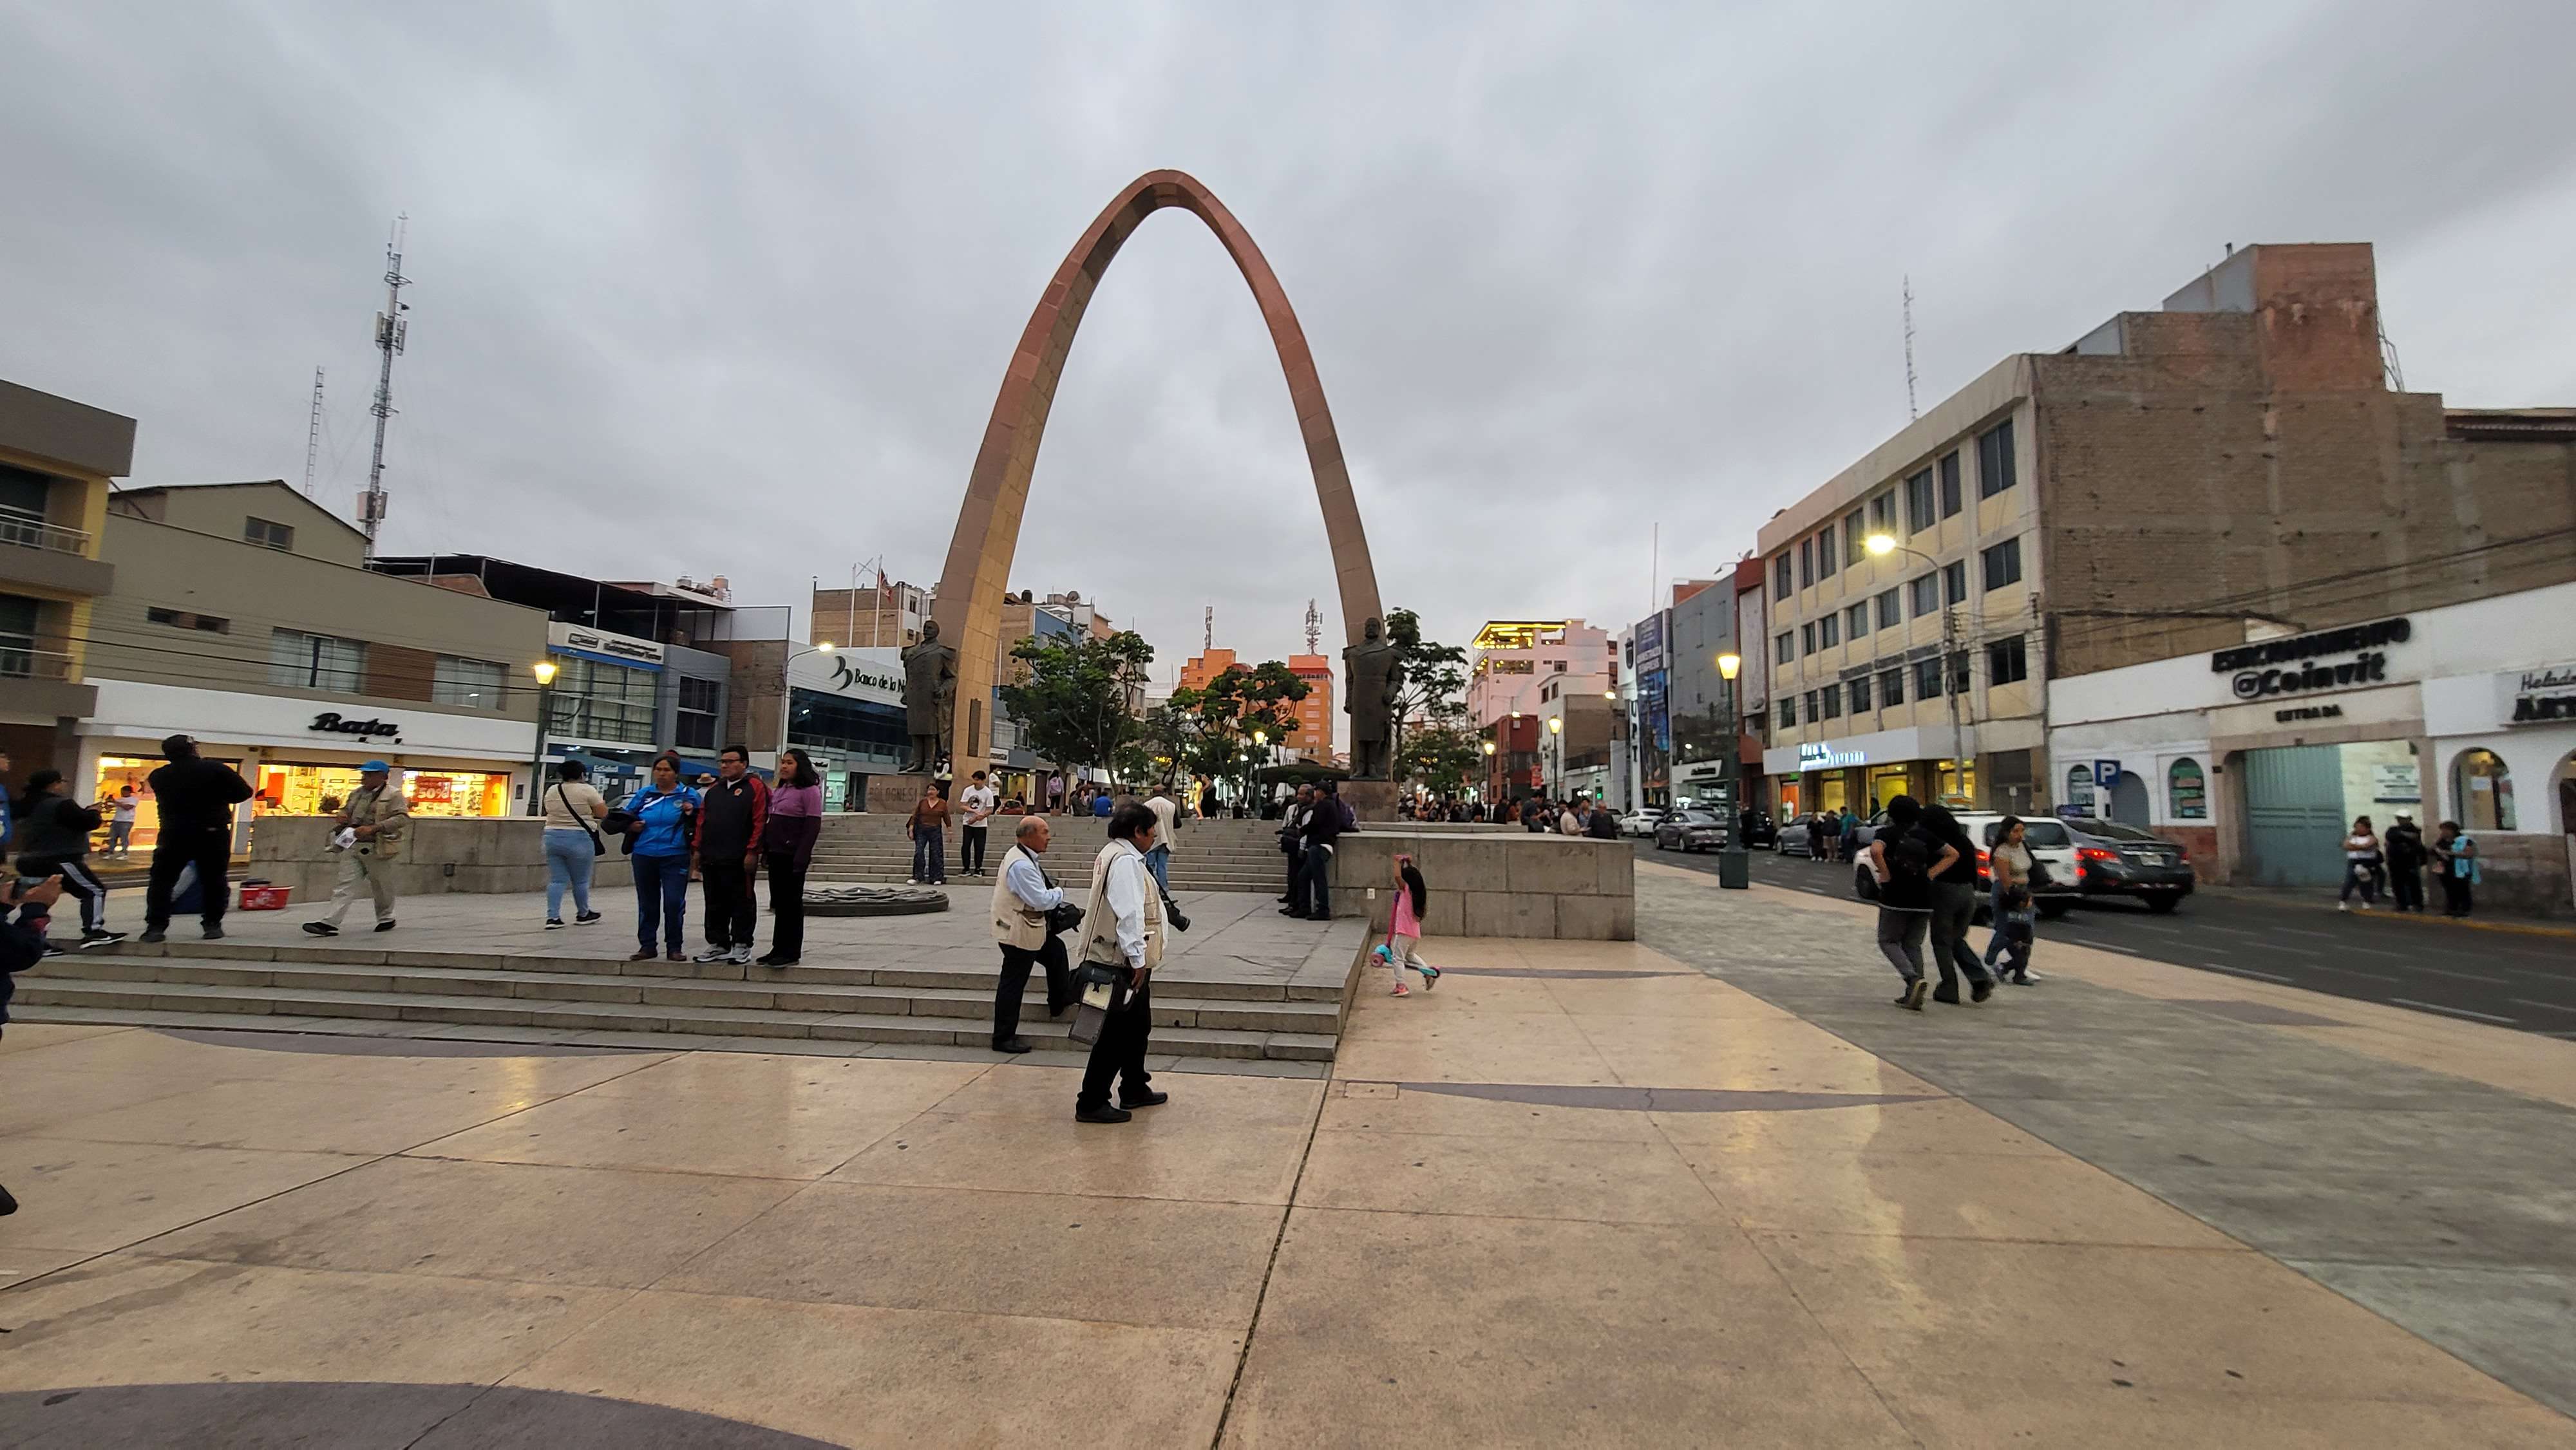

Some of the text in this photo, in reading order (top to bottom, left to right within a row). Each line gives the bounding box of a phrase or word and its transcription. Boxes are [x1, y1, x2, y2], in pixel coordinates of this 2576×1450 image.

[855, 668, 877, 686] Banco
[879, 675, 888, 689] de
[890, 677, 896, 691] la
[308, 712, 400, 736] Bata
[2101, 763, 2117, 783] P
[417, 787, 449, 799] 50%
